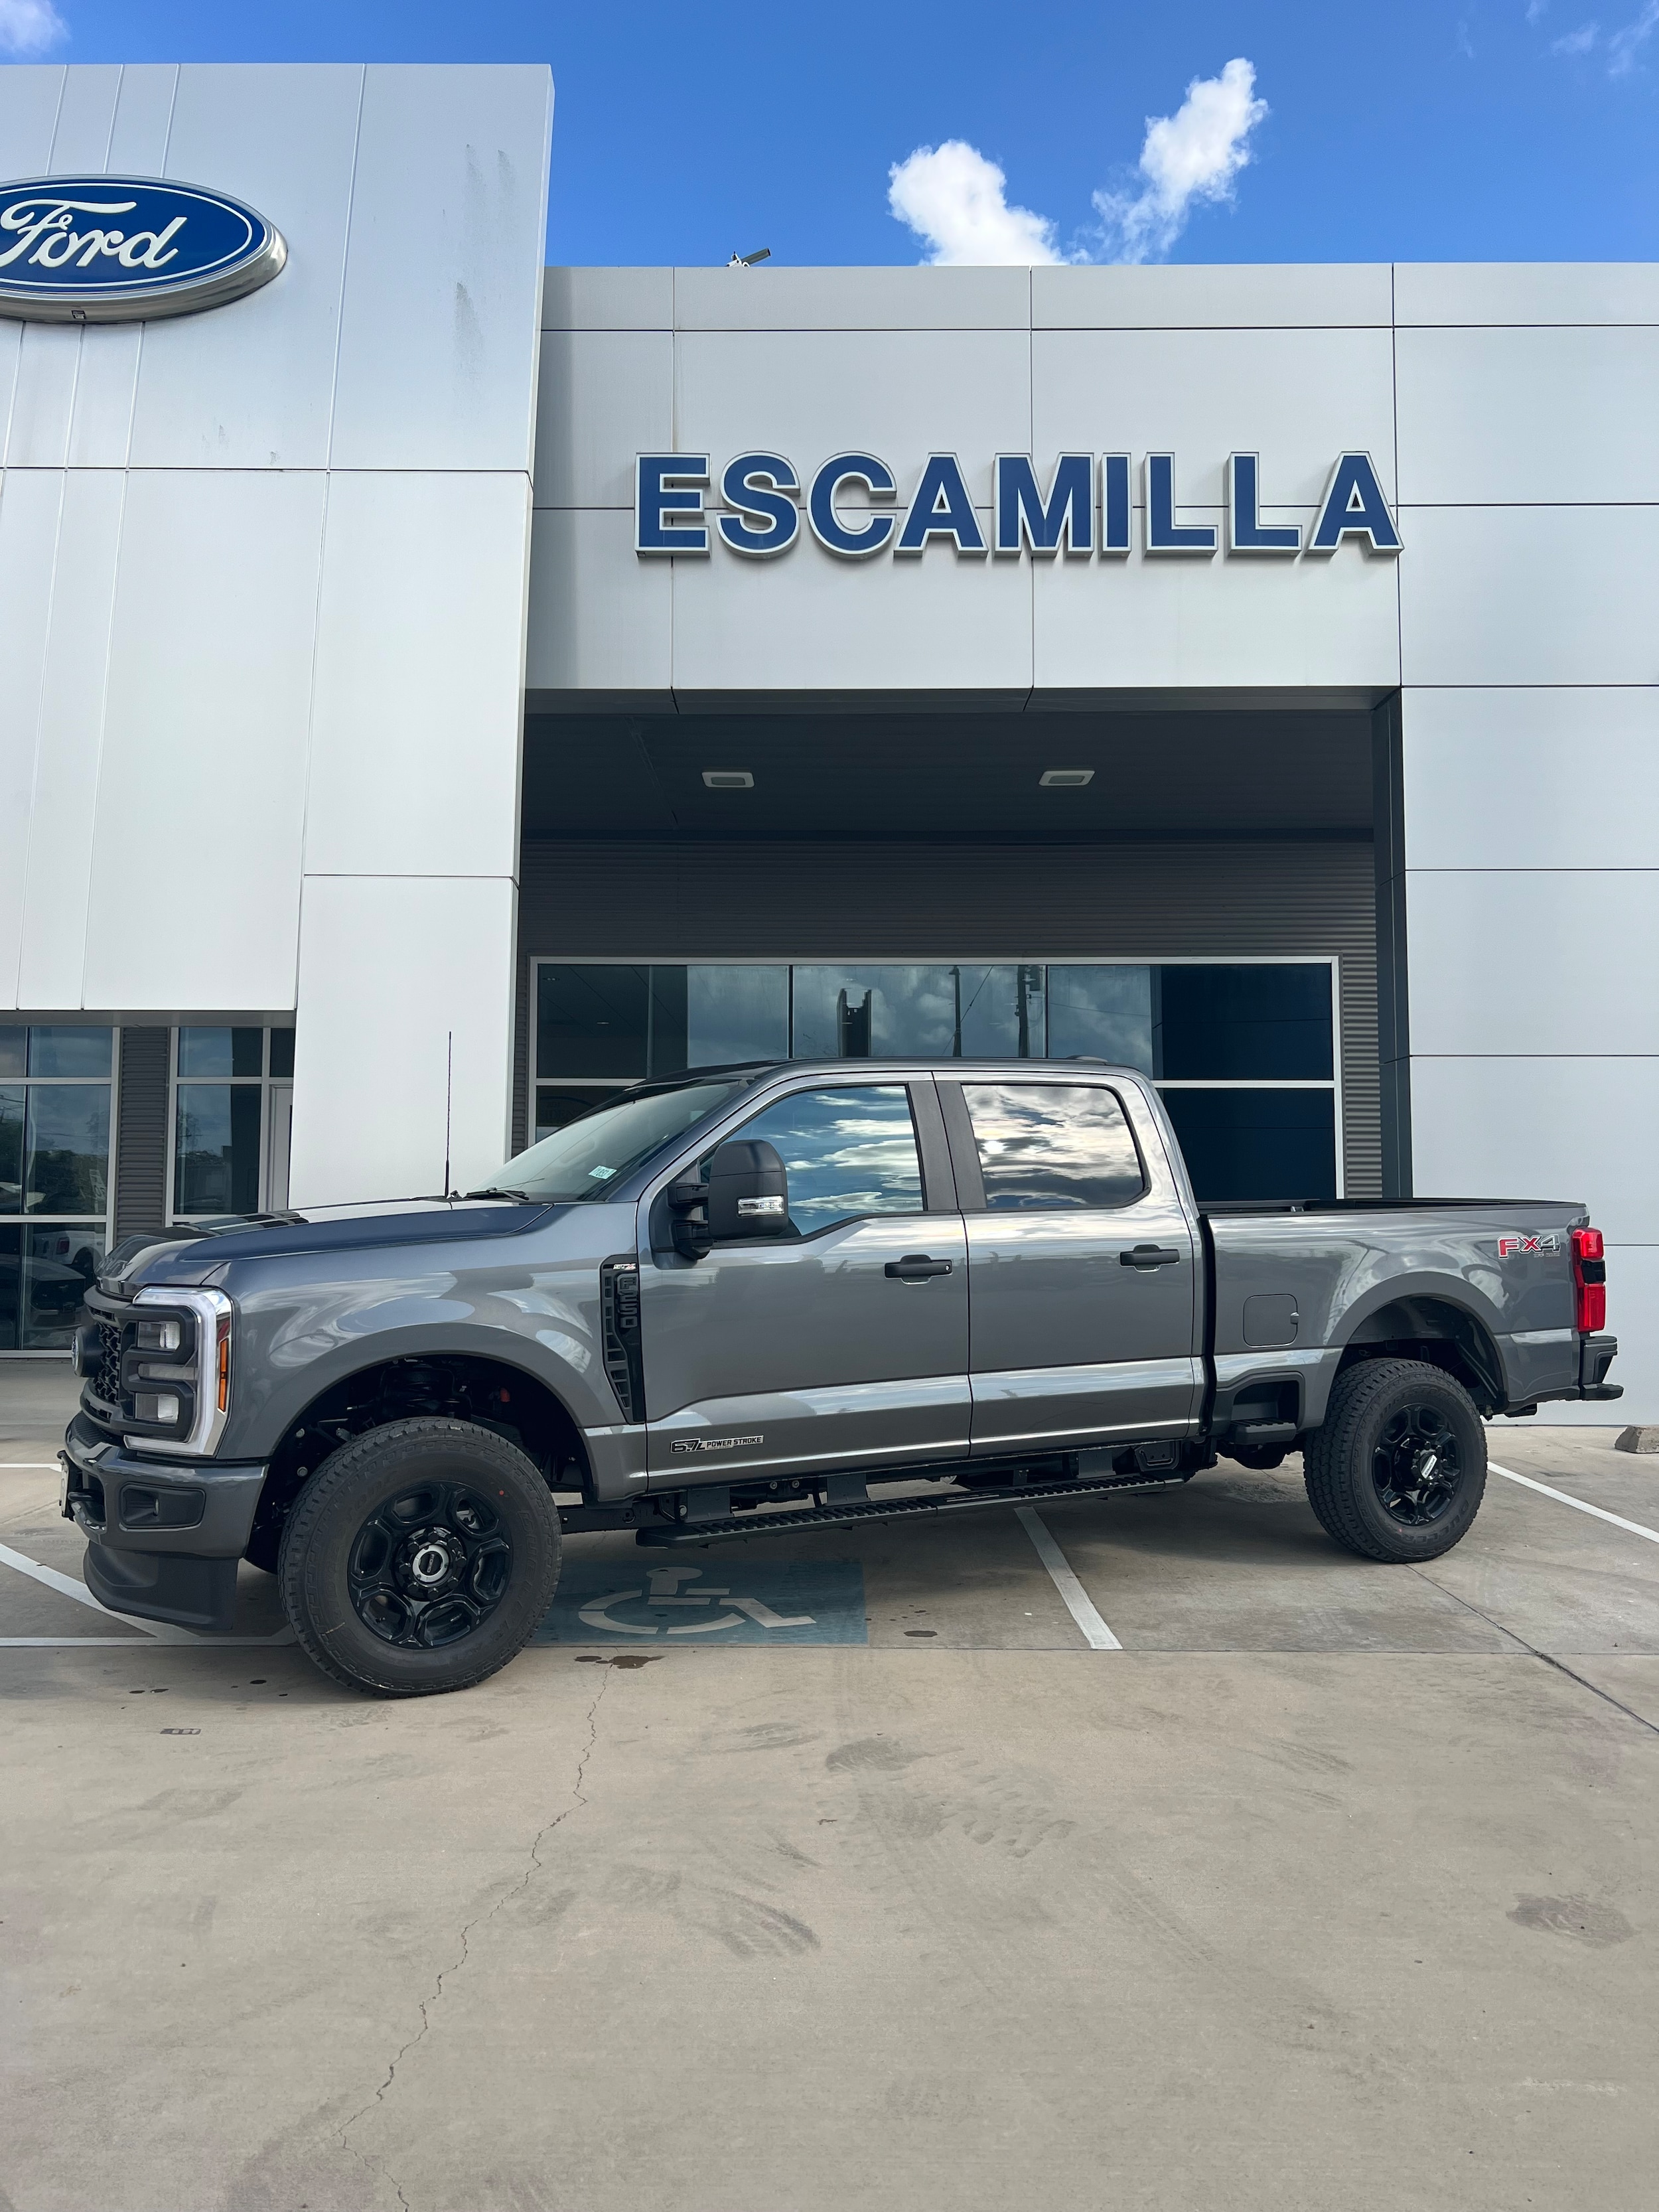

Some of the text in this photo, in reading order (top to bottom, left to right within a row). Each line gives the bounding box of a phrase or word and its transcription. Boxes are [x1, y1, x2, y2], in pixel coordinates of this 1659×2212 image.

[0, 200, 188, 268] Ford
[635, 451, 1405, 558] ESCAMILLA
[1498, 1234, 1560, 1259] FX4
[733, 1437, 762, 1445] STROKE
